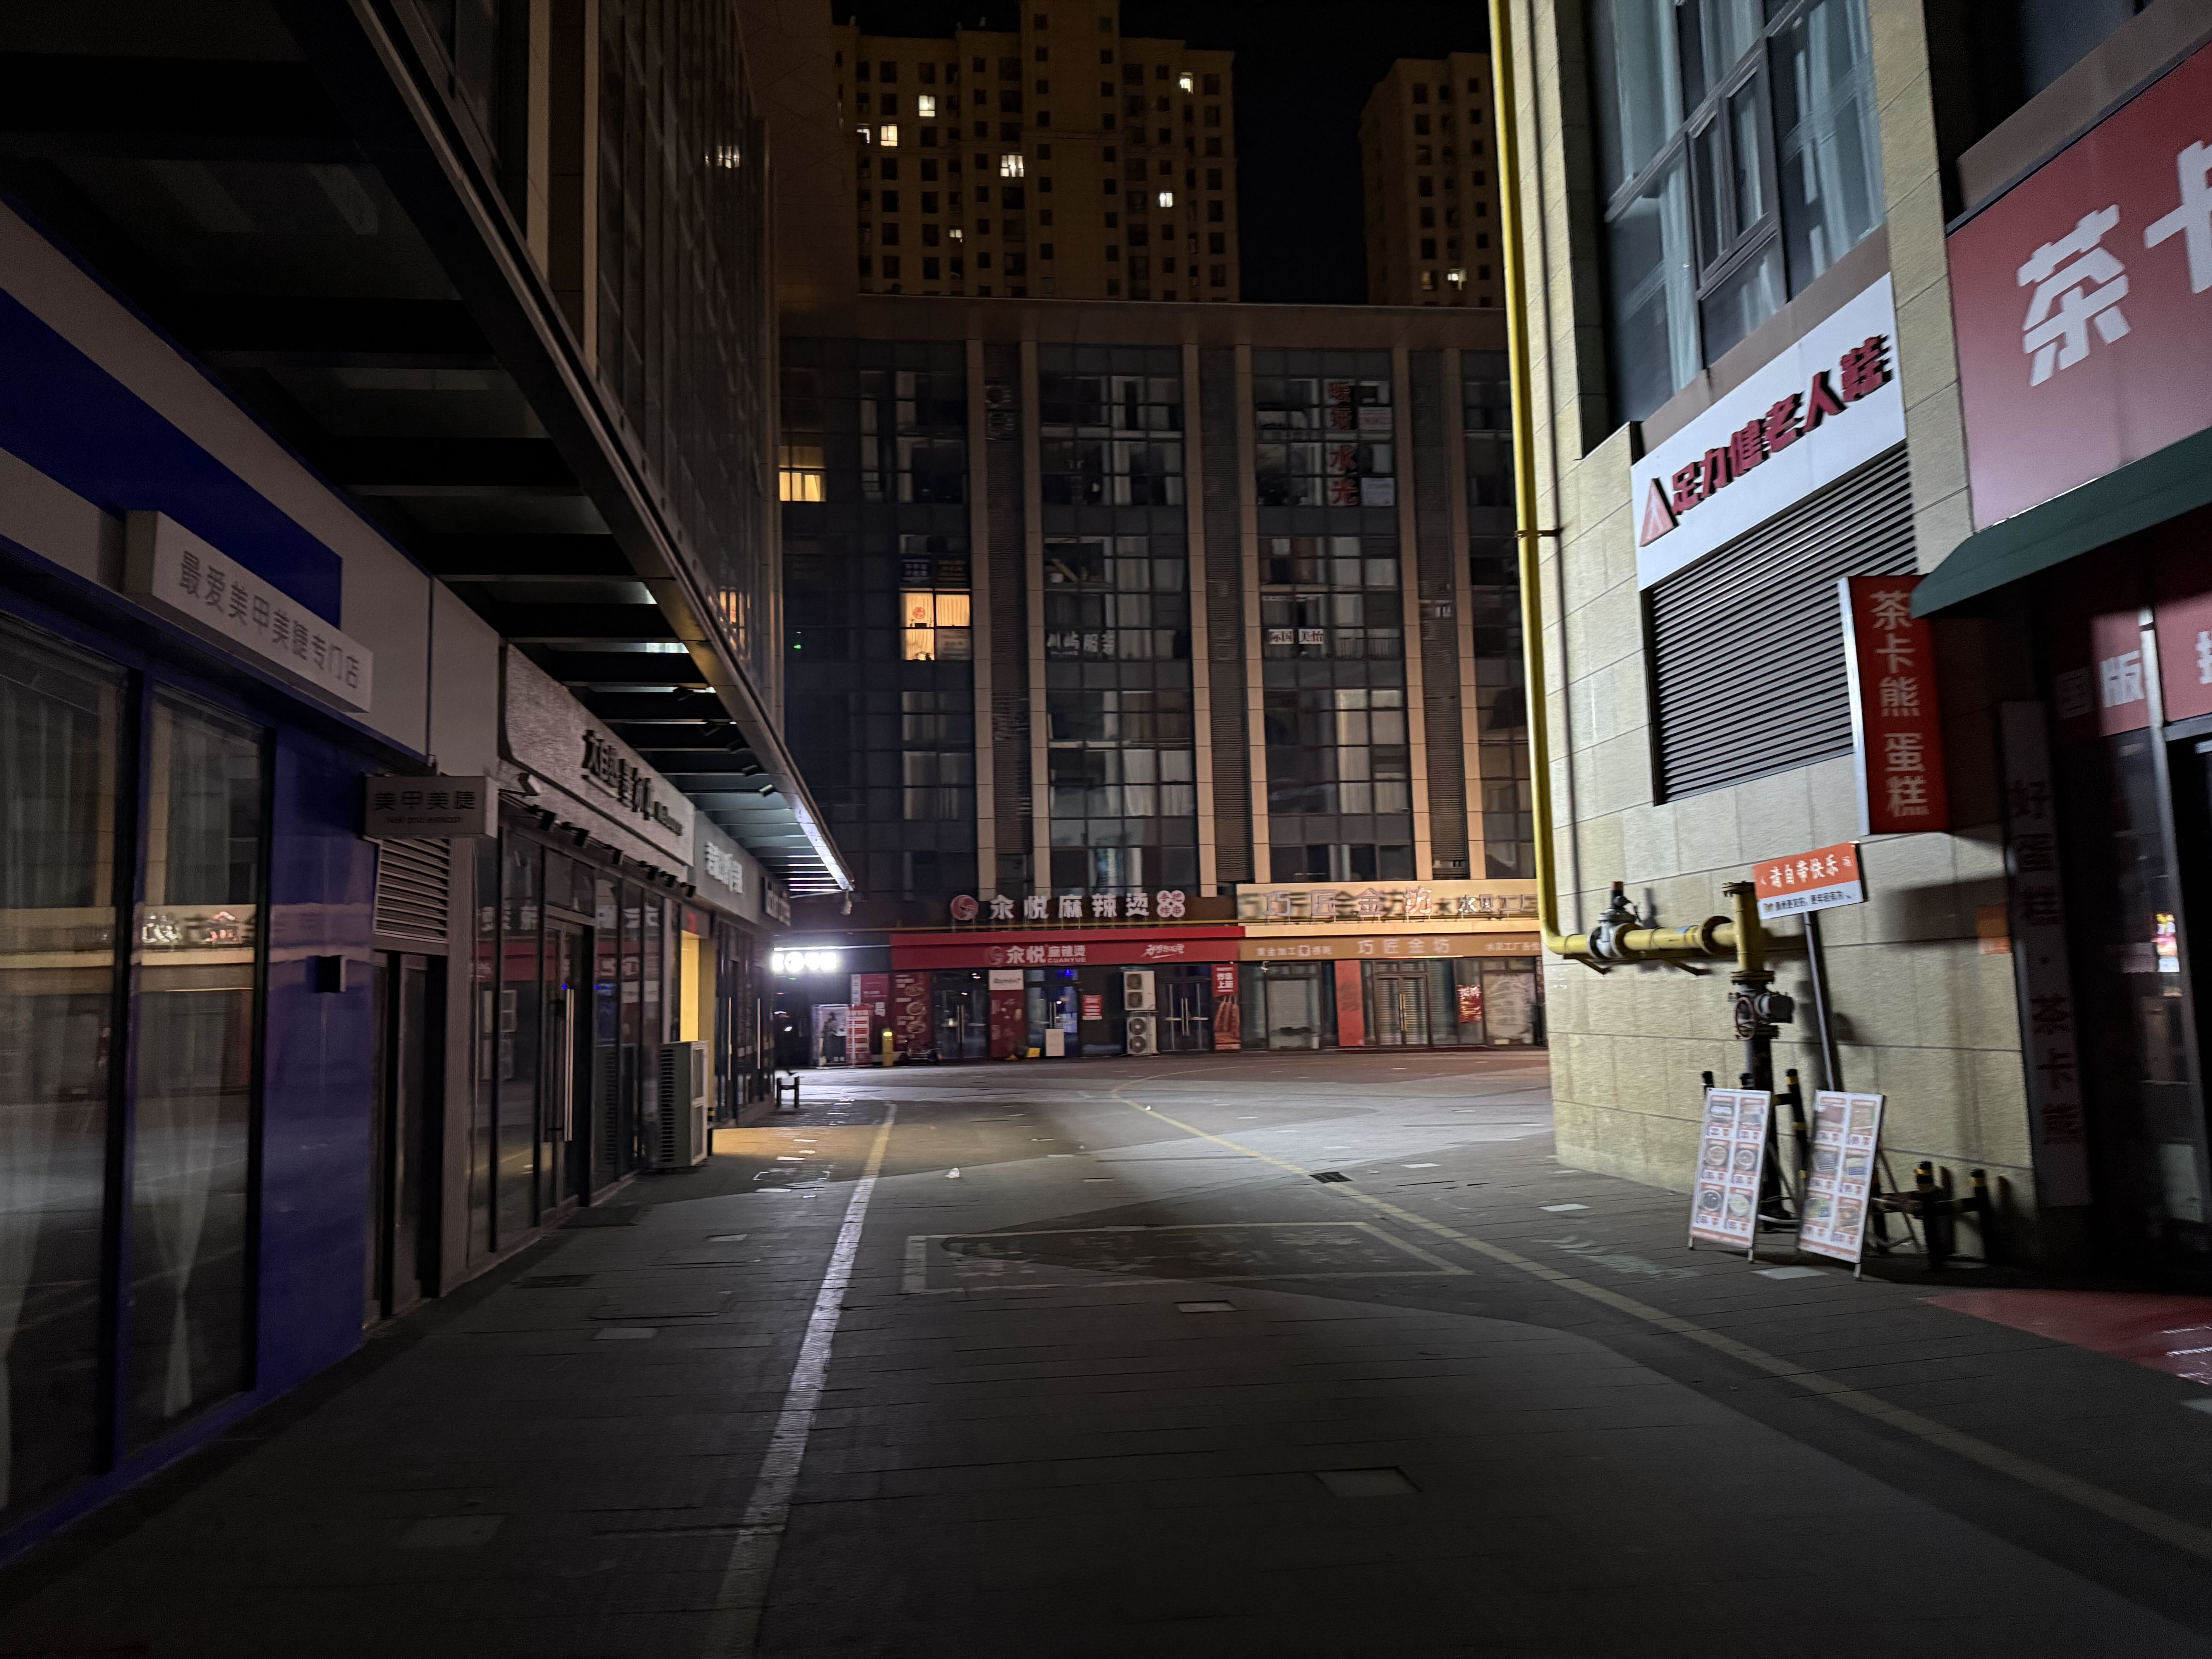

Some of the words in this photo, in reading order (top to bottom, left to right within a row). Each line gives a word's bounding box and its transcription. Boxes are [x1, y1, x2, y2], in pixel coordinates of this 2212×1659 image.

[1670, 334, 1894, 516] 足力健老人鞋
[1263, 886, 1433, 917] 巧匠金坊
[1357, 939, 1451, 956] 巧匠金坊
